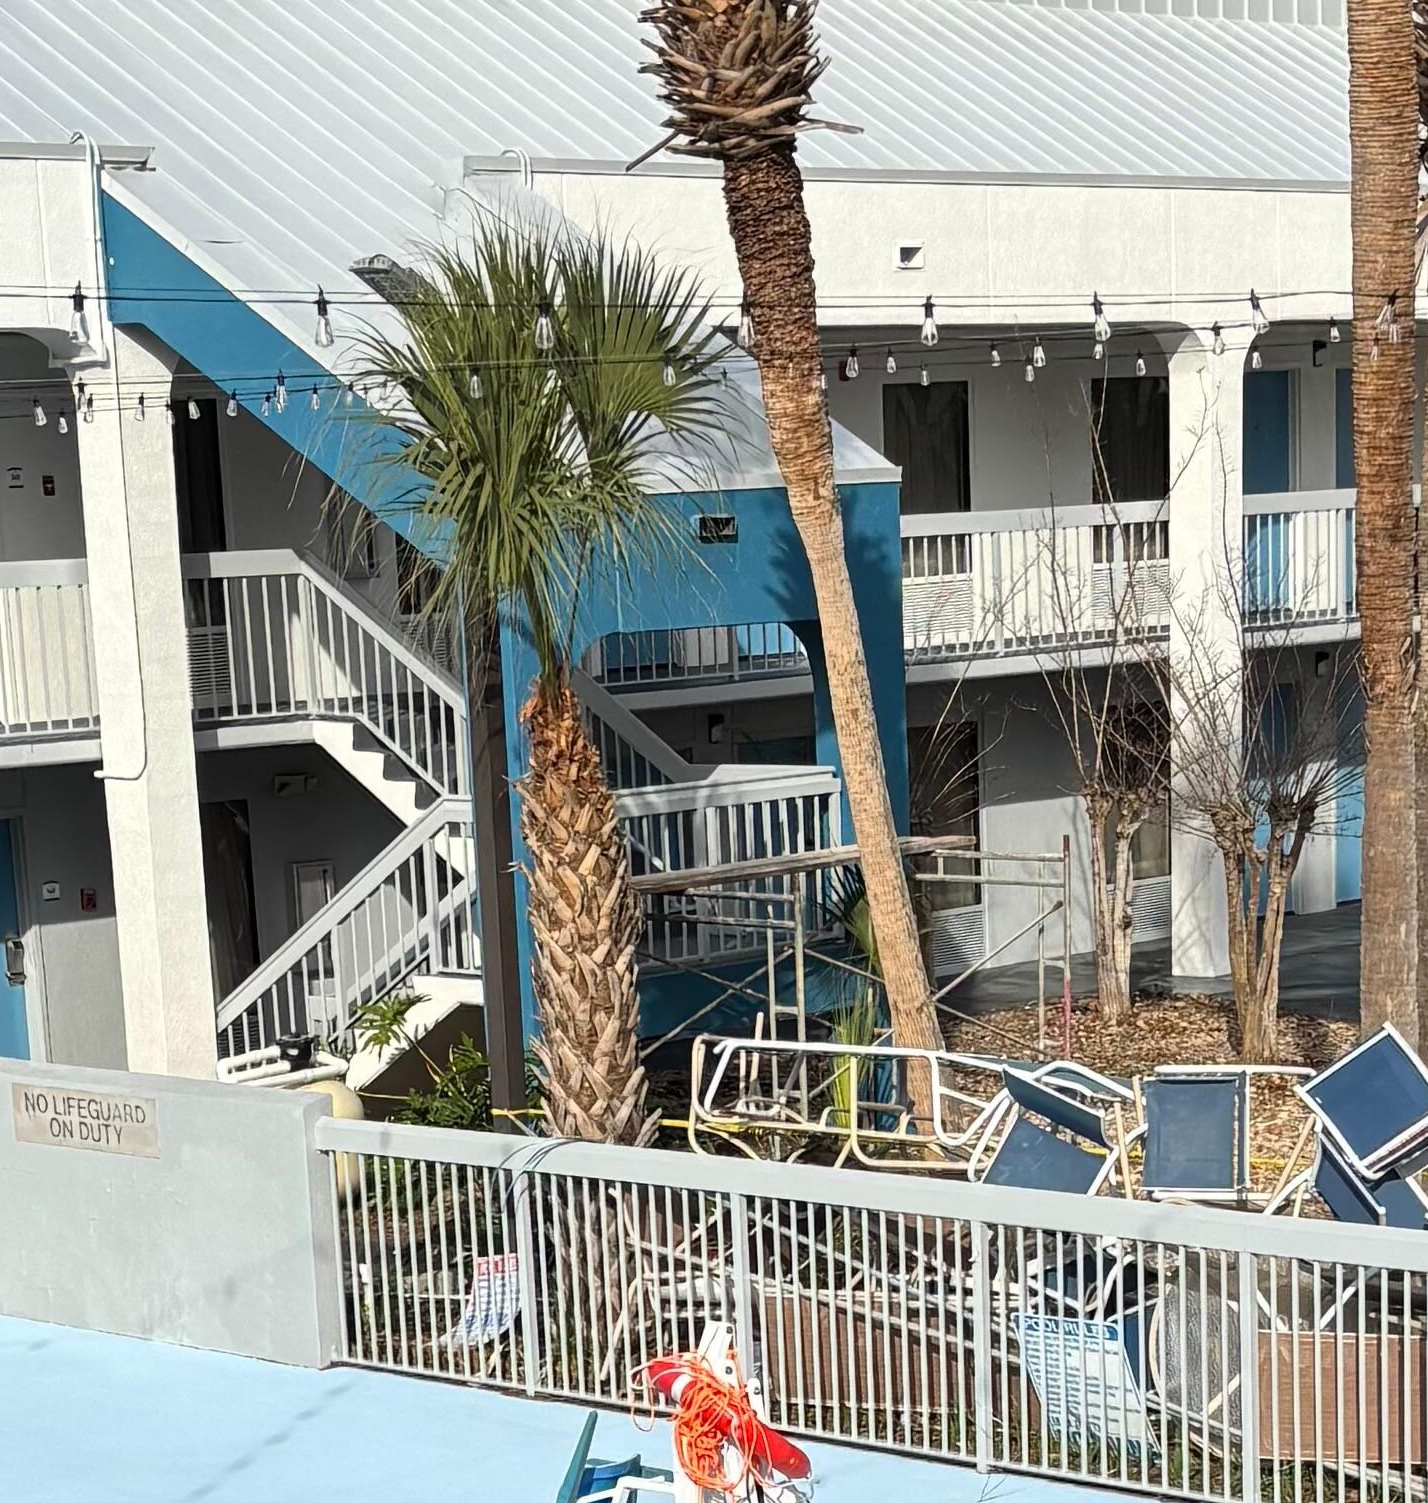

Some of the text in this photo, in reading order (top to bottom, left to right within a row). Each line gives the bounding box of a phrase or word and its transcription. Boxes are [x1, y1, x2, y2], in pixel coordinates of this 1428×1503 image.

[24, 1092, 146, 1124] NO LIFEGUARD
[50, 1118, 123, 1144] ON DUTY
